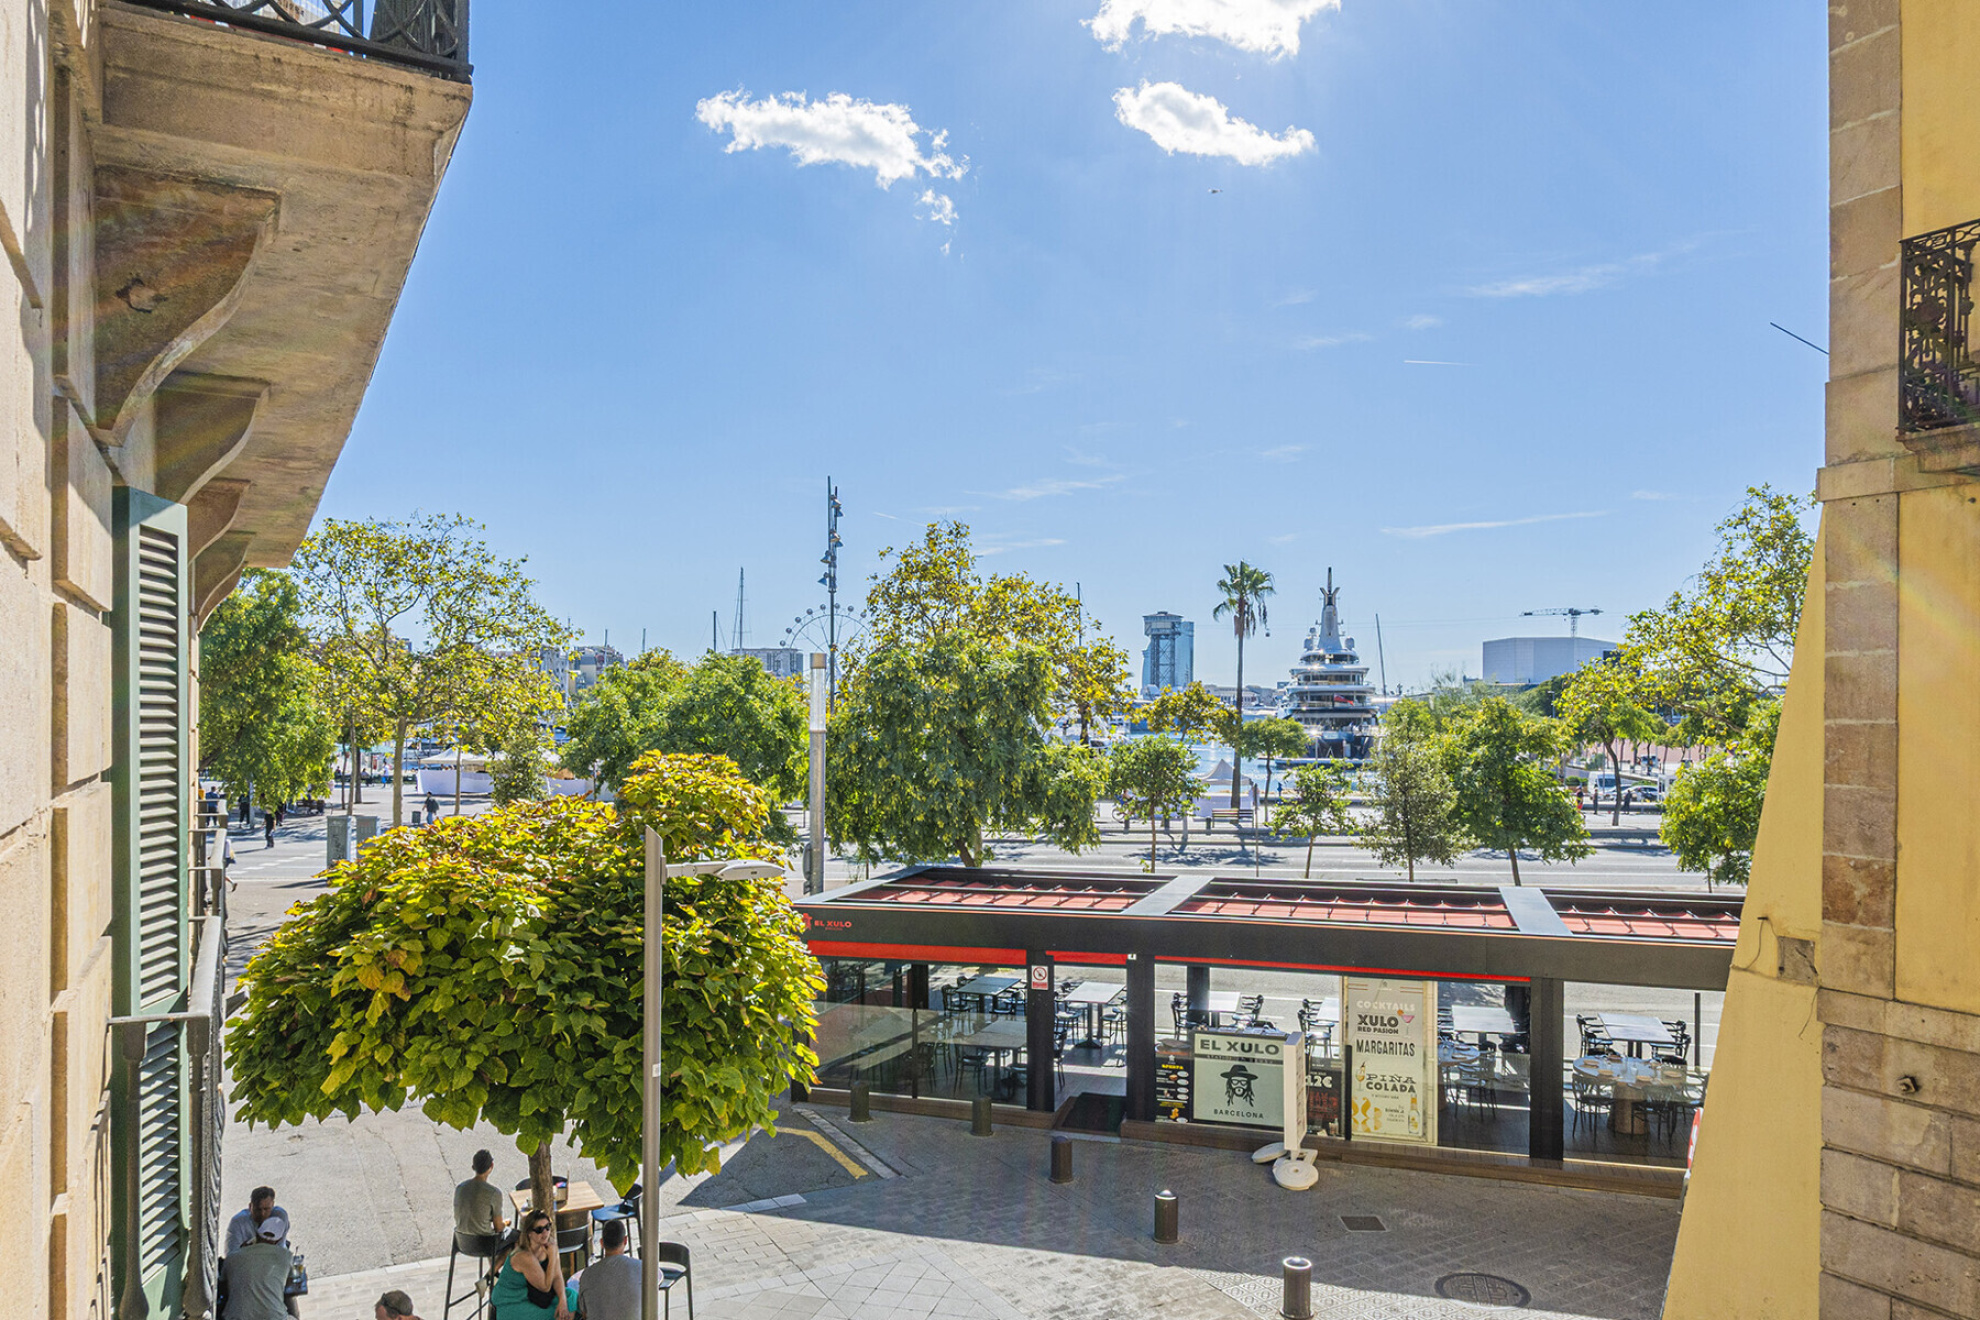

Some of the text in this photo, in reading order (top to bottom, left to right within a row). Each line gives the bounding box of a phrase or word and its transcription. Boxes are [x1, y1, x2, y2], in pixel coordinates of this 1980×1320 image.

[827, 920, 852, 928] XULO
[1356, 1000, 1416, 1011] COCKTAILS
[1357, 1014, 1399, 1028] XULO
[1200, 1039, 1280, 1055] EL XULO
[1356, 1038, 1416, 1057] MARGARITAS
[1305, 1075, 1333, 1088] 12€
[1366, 1073, 1417, 1084] PIÑA
[1366, 1081, 1416, 1093] COLADA
[1213, 1108, 1264, 1119] BARCELONA
